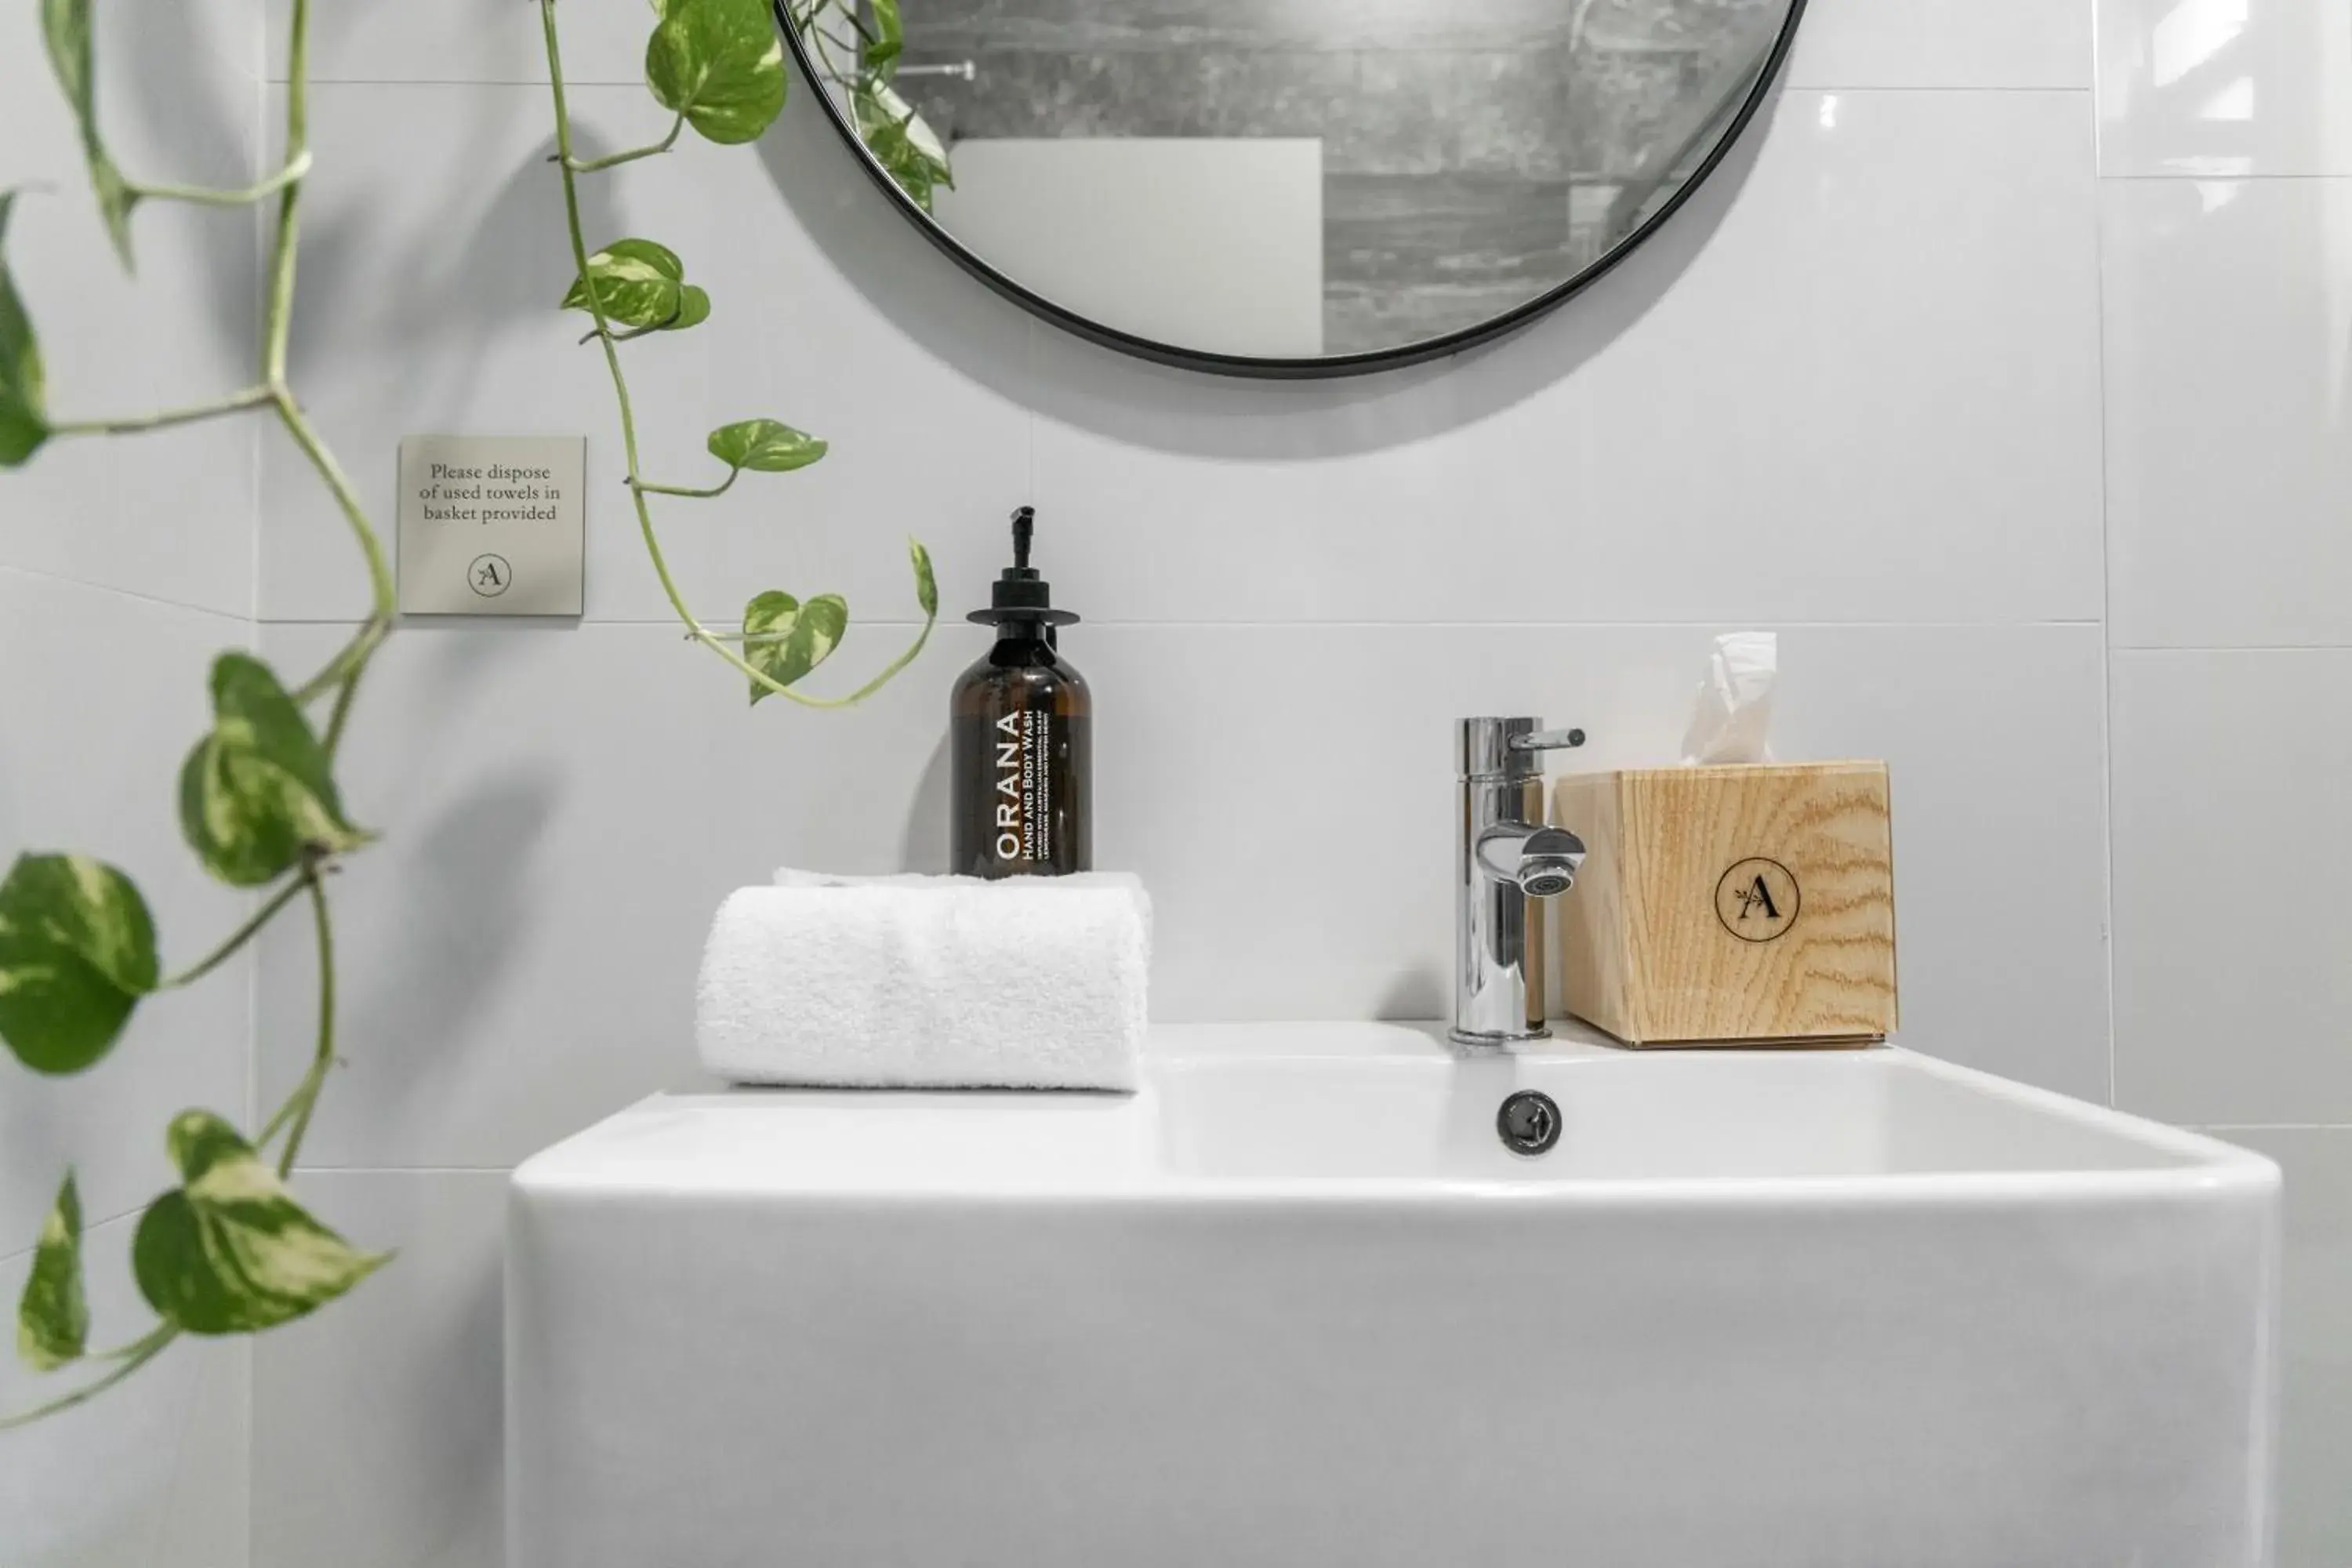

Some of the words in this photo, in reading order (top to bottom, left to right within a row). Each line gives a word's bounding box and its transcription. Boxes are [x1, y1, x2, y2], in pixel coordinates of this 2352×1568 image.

[430, 463, 482, 479] Please
[488, 464, 550, 483] dispose
[419, 484, 441, 499] of
[443, 485, 481, 499] used
[487, 485, 539, 500] towels
[544, 485, 561, 499] in
[423, 505, 477, 520] basket
[481, 505, 557, 524] provided
[1022, 710, 1034, 750] WASH
[996, 710, 1019, 859] ORANA
[1022, 753, 1034, 789] BODY
[1023, 792, 1034, 818] AND
[1022, 823, 1034, 860] HAND
[1738, 874, 1782, 919] A
